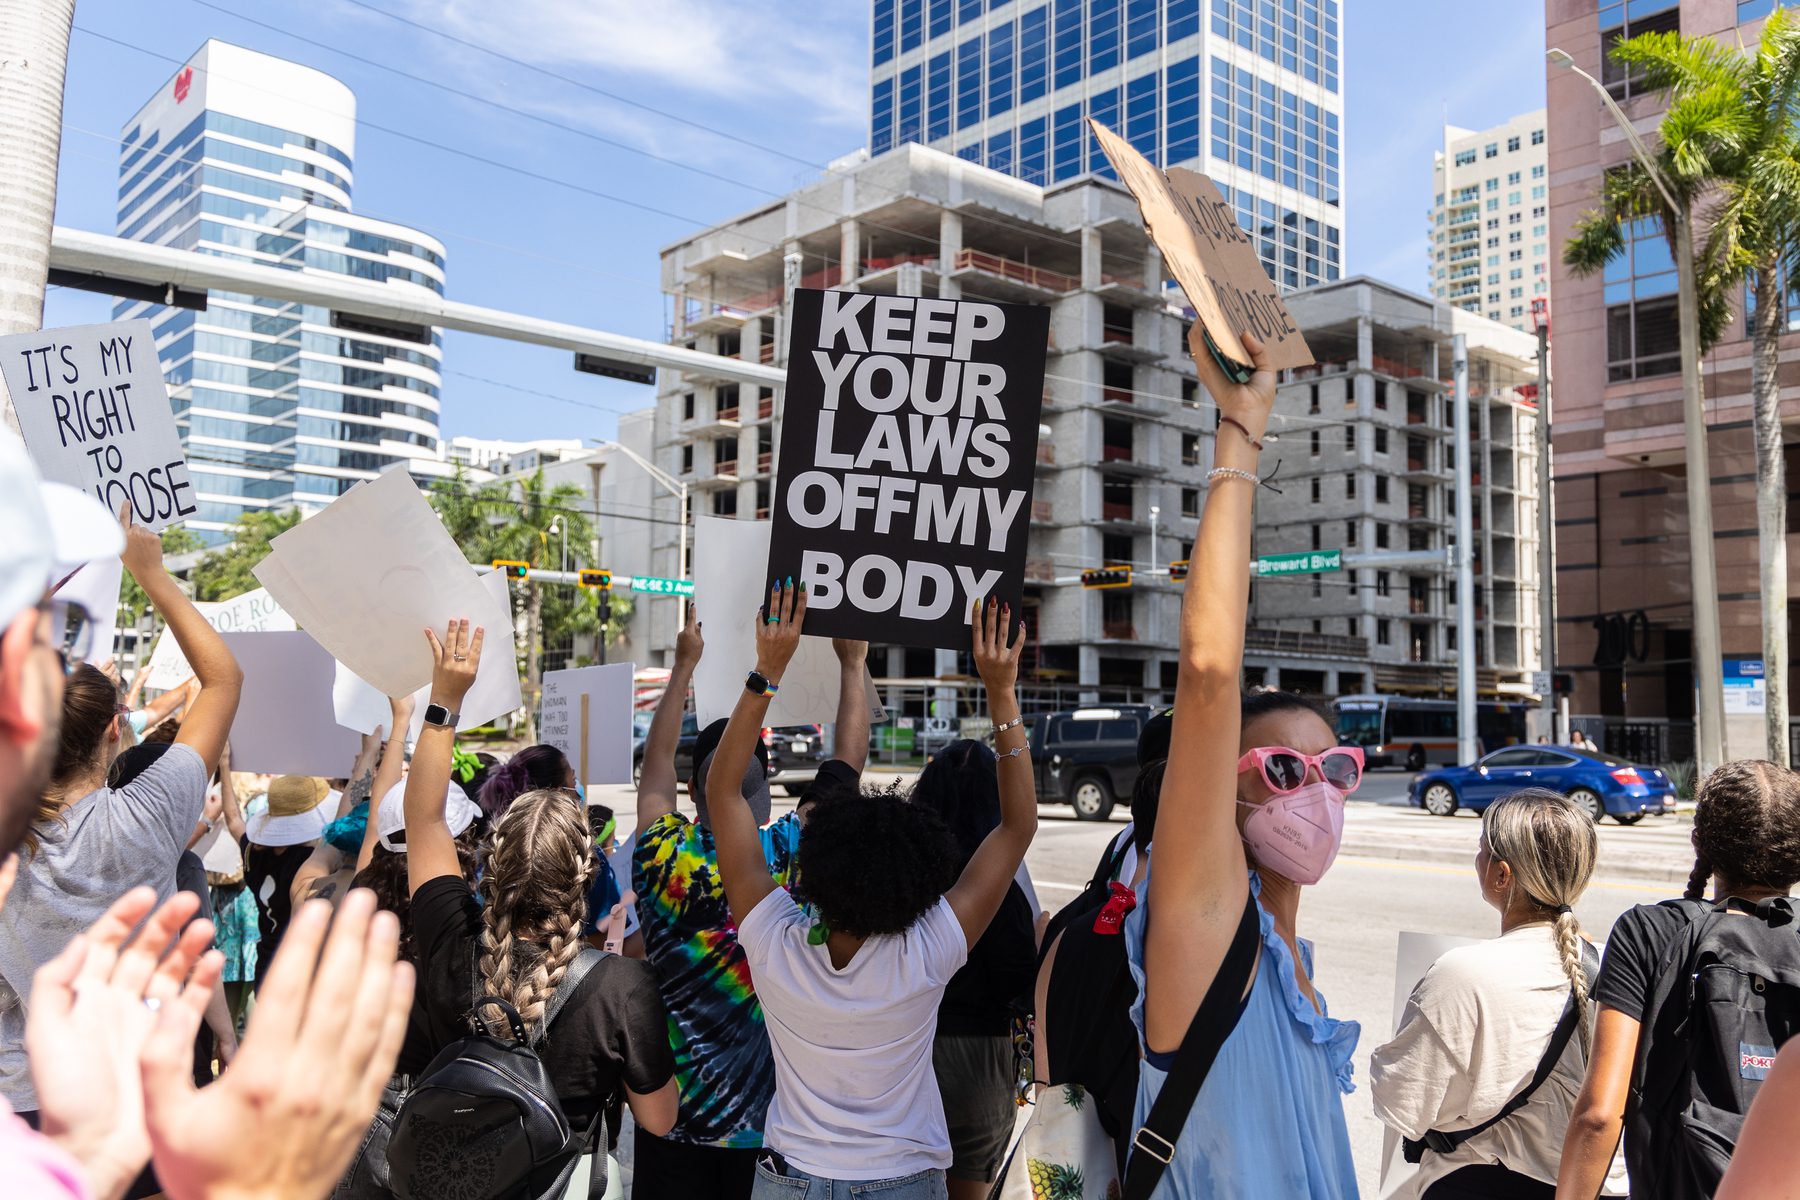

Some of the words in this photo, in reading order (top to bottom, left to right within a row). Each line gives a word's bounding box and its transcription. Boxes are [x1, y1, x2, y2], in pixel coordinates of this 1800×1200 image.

[818, 290, 1006, 361] KEEP
[21, 343, 79, 392] IT'S
[99, 336, 133, 377] MY
[811, 350, 1007, 421] YOUR
[52, 383, 135, 447] RIGHT
[814, 409, 1011, 478] LAWS
[86, 445, 122, 478] TO
[665, 581, 674, 593] 3
[800, 549, 1003, 626] BODY
[1258, 556, 1309, 573] Broward
[1310, 553, 1340, 570] Blvd
[1282, 825, 1302, 840] KN95
